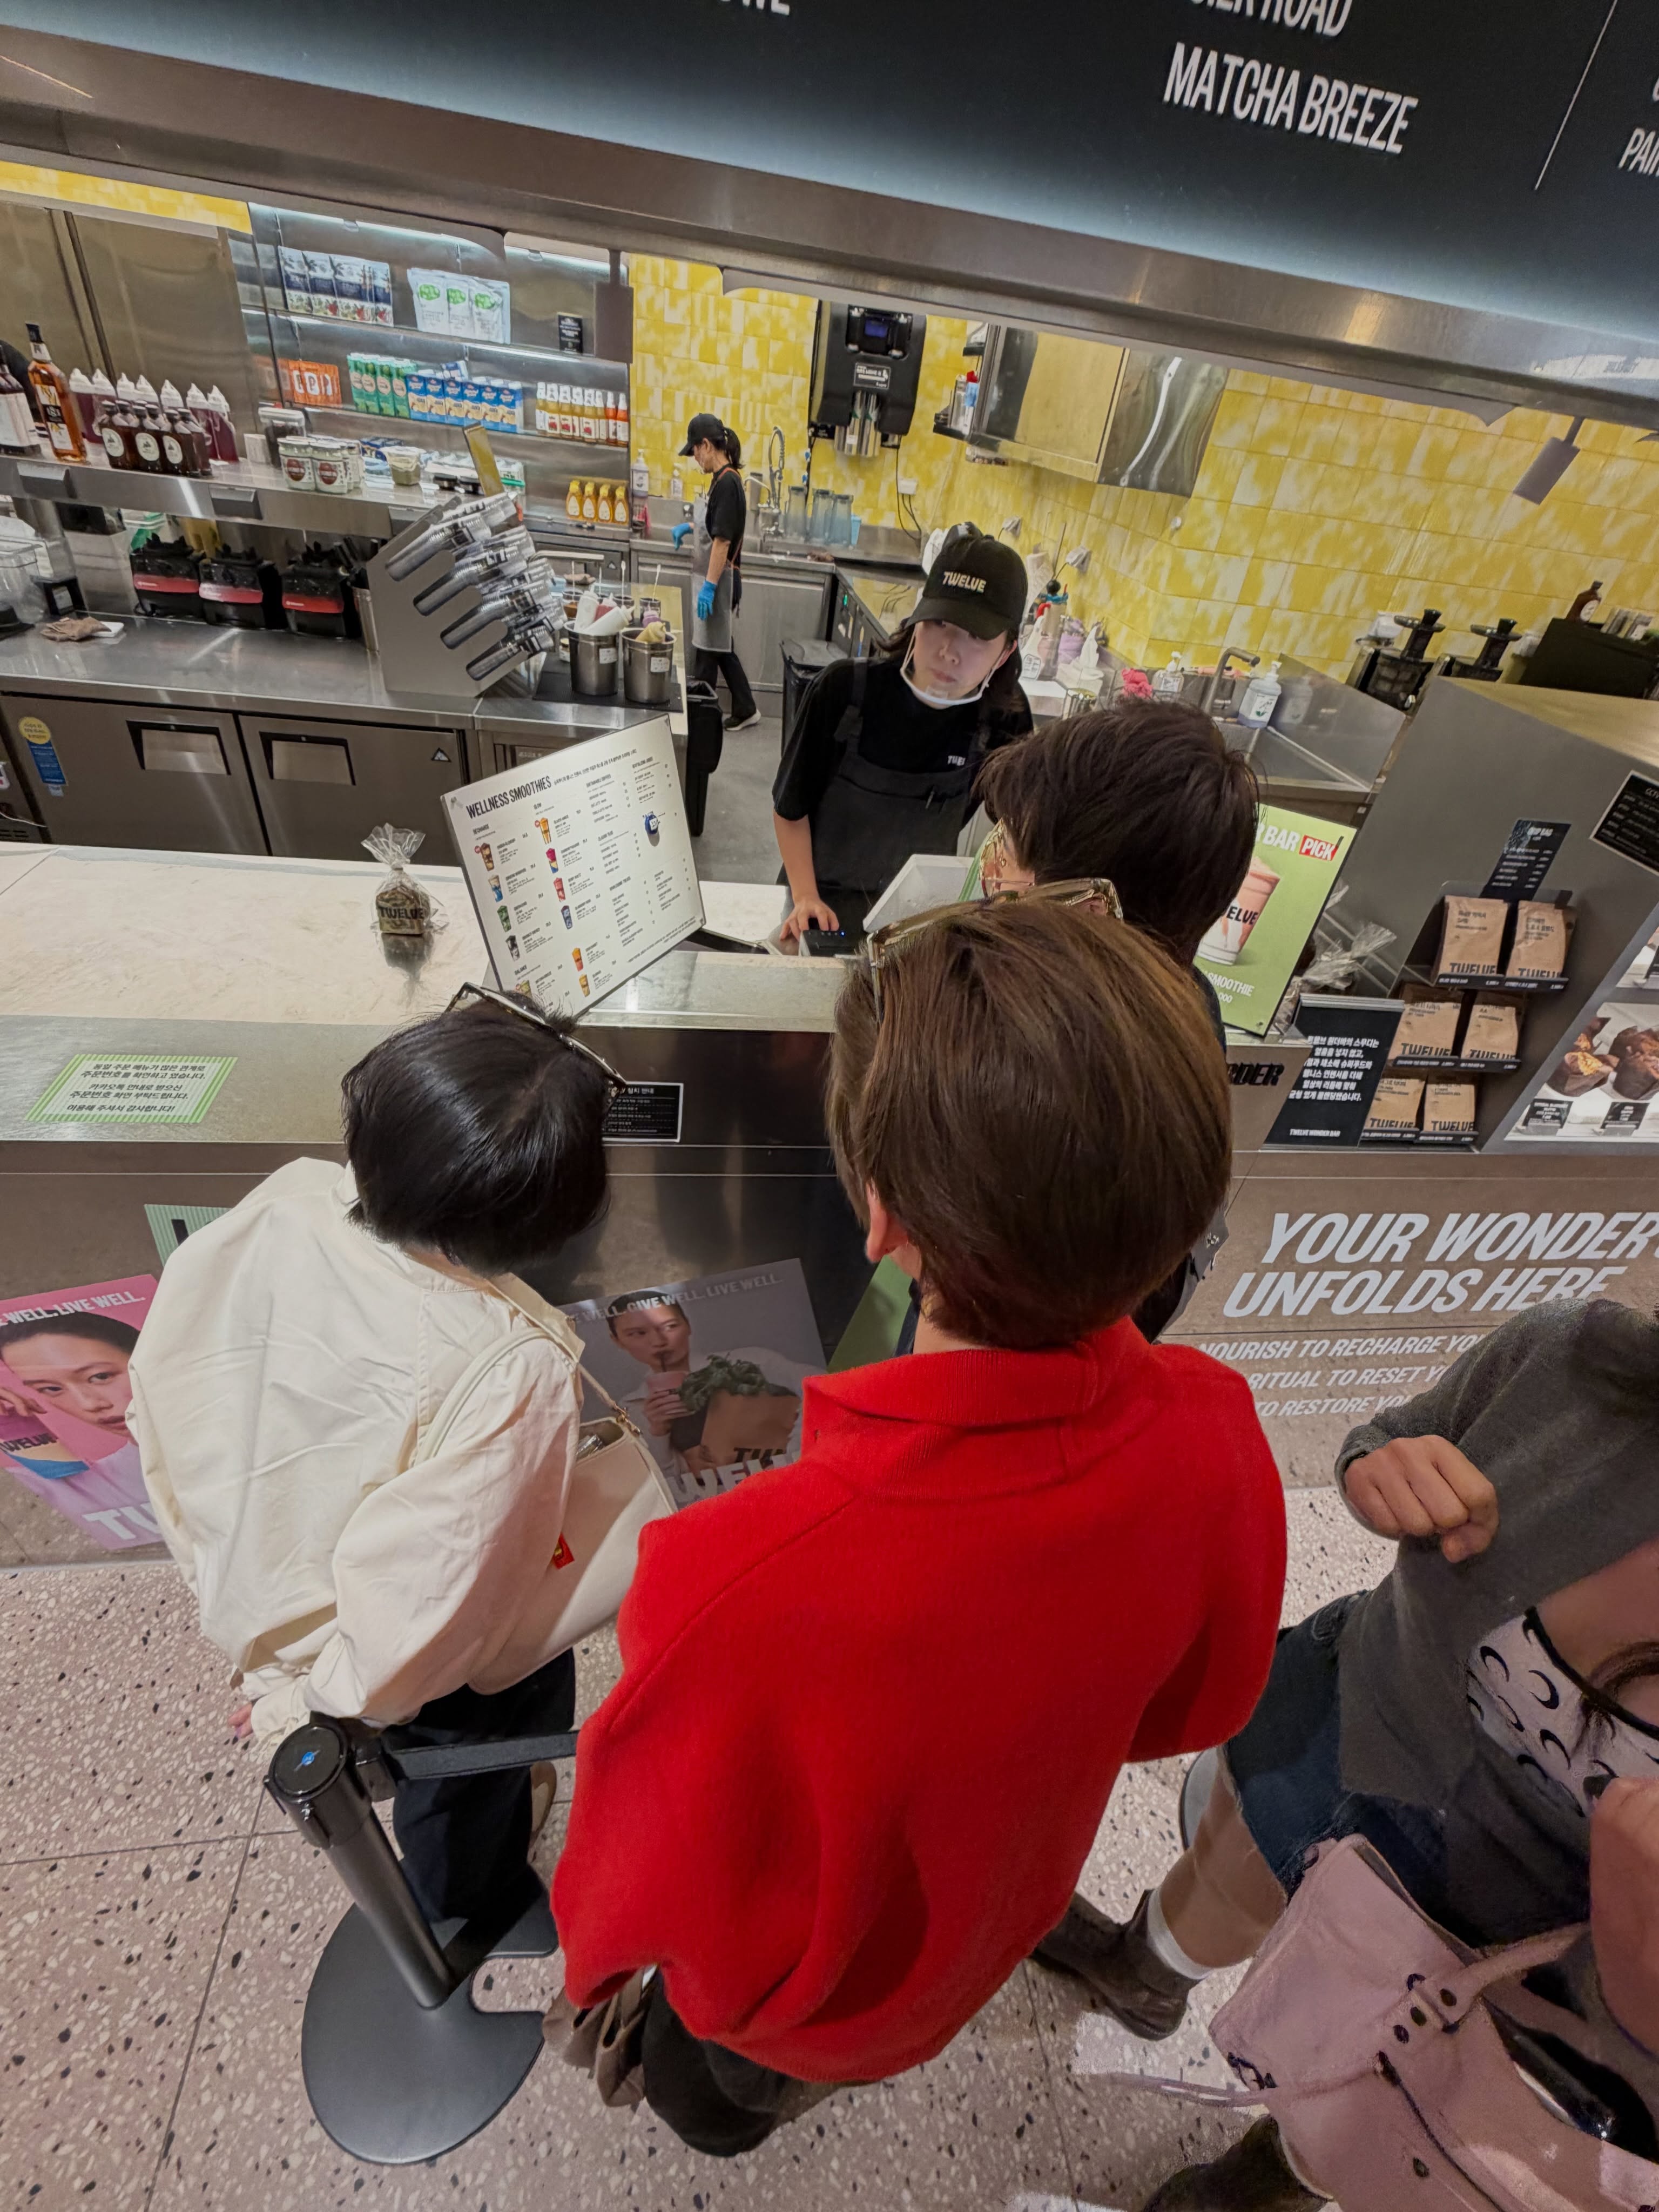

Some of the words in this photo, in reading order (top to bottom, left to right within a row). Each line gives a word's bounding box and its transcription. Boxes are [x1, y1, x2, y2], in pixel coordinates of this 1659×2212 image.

[1163, 42, 1300, 130] MATCHA
[1298, 75, 1418, 154] BREEZE
[942, 571, 987, 594] TWELVE
[466, 792, 509, 819] WELLNESS
[509, 775, 552, 802] SMOOTHIES
[1263, 825, 1300, 852] BAR
[1301, 838, 1336, 861] PICK
[378, 907, 424, 919] TWELVE
[1226, 906, 1258, 925] ELVE
[1208, 972, 1255, 997] SMOOTHIE
[1228, 1062, 1285, 1087] RDER
[1261, 1213, 1429, 1264] YOUR
[1223, 1269, 1483, 1318] UNFOLDS
[4, 1307, 59, 1324] WELL.
[52, 1299, 95, 1315] LIVE
[91, 1291, 146, 1308] WELL.
[1298, 1339, 1331, 1358] TO
[1327, 1336, 1448, 1357] RECHARGE
[1248, 1370, 1322, 1390] RITUAL
[1326, 1369, 1358, 1387] TO
[1354, 1366, 1427, 1386] RESET
[1278, 1395, 1376, 1417] RESTORE
